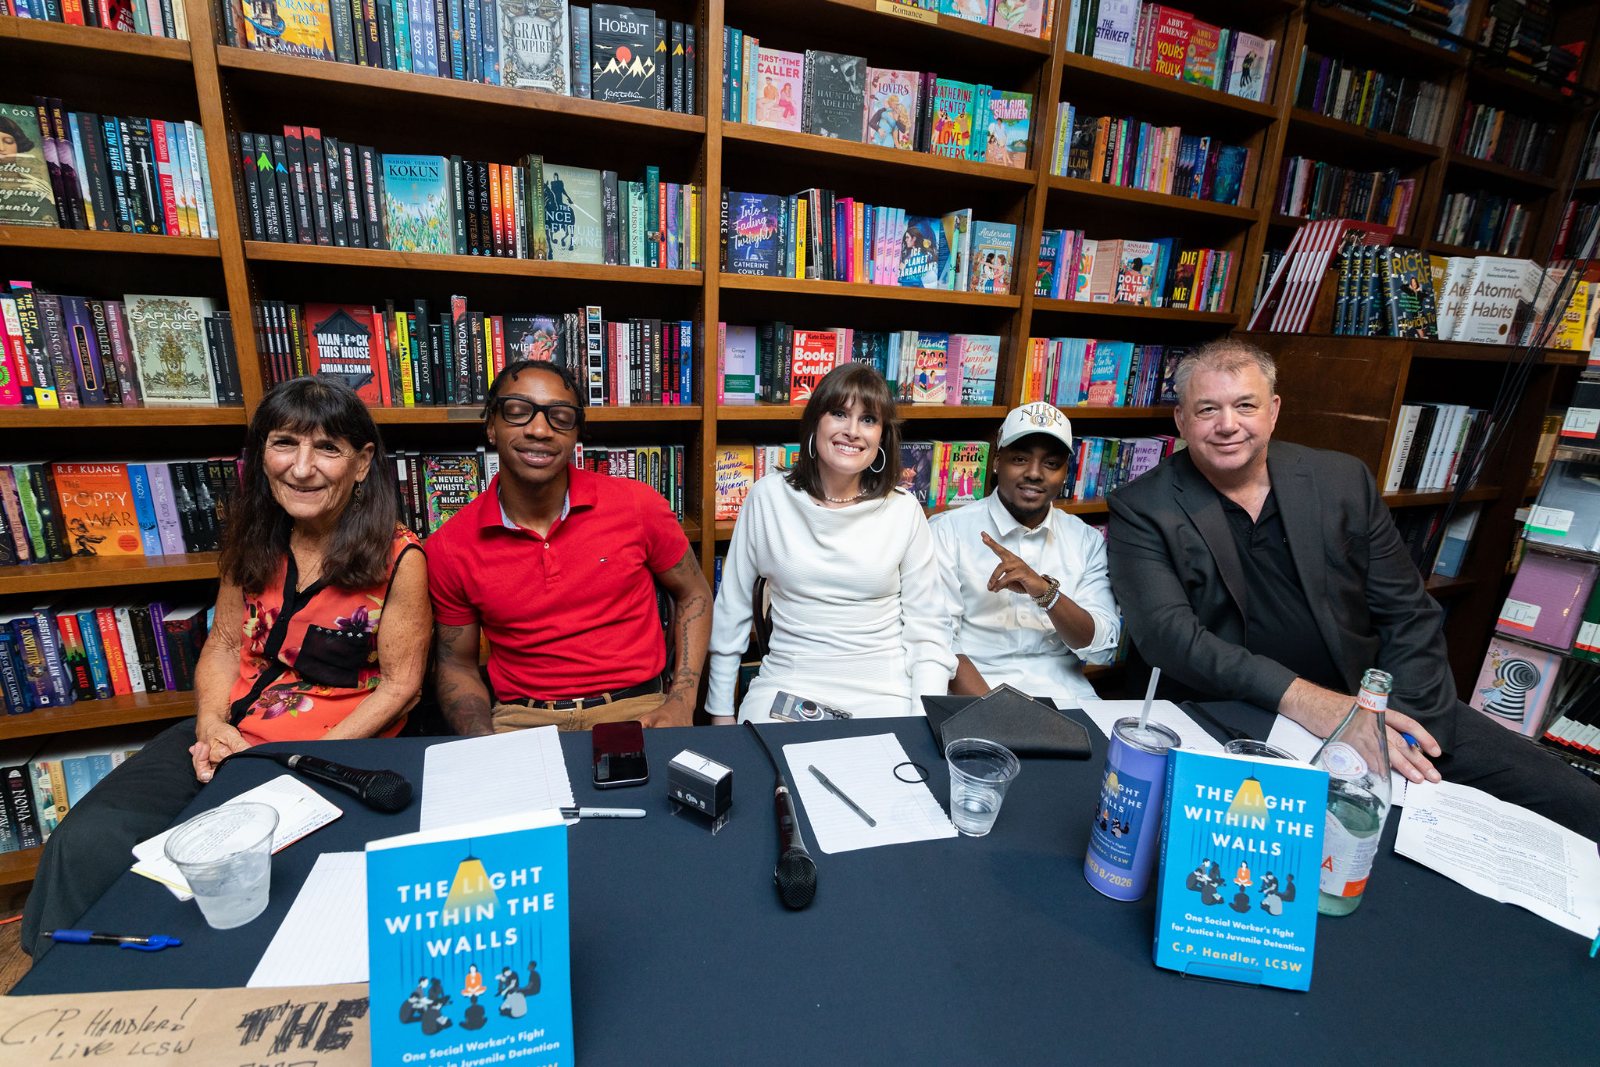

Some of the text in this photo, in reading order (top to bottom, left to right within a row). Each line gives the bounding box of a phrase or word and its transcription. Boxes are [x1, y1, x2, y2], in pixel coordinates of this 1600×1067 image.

[396, 2, 404, 24] HEELS
[891, 4, 924, 19] Romance
[292, 14, 320, 26] TREE
[598, 18, 649, 36] HOBBIT
[1101, 19, 1114, 29] THE
[1166, 17, 1185, 29] ABBY
[370, 22, 378, 42] FIELD
[513, 21, 552, 40] GRAVE
[1095, 27, 1130, 44] STRIKER
[1158, 24, 1189, 40] JIMENEZ
[1196, 28, 1213, 40] ABBY
[270, 40, 325, 57] SAMANTHA
[514, 38, 552, 54] EMPIRE
[1157, 40, 1185, 60] YOURS
[1190, 36, 1217, 50] JIMENEZ
[758, 54, 800, 67] FIRST-TIME
[1155, 60, 1181, 76] TRULY
[757, 62, 800, 79] CALLER
[818, 90, 862, 102] HAUNTING
[878, 82, 910, 96] LOVERS
[935, 86, 972, 101] KATHERINE
[822, 100, 856, 110] ADELINE
[940, 100, 967, 116] CENTER
[989, 98, 1026, 110] RICH GIRL
[993, 108, 1028, 120] SUMMER
[938, 130, 961, 144] LOVE
[930, 146, 966, 158] HATERS
[104, 122, 129, 221] SLOW RIVER NICOLA GRIFFITH
[389, 166, 438, 178] KOKUN
[466, 164, 474, 188] ANDY
[470, 212, 478, 246] ARTEMIS
[739, 204, 760, 218] Into
[282, 196, 294, 238] SILMARILLION
[546, 212, 572, 222] NCE
[734, 215, 768, 231] Fading
[482, 214, 490, 248] ARTEMIS
[730, 226, 771, 249] Twilight
[978, 228, 1011, 239] Anderson
[910, 246, 921, 256] ICE
[991, 239, 1012, 248] Bloom
[1126, 242, 1150, 250] ANNABEL
[734, 261, 768, 270] CATHERINE
[904, 255, 928, 268] PLANET
[1180, 251, 1197, 266] DIE
[1392, 255, 1424, 274] RICH
[738, 268, 764, 276] COWLES
[1118, 274, 1148, 285] DOLLY
[1418, 268, 1430, 284] AF
[1132, 284, 1147, 292] THE
[1172, 286, 1187, 300] ME
[1474, 281, 1522, 299] Atomic
[1119, 292, 1142, 302] TIME
[16, 298, 26, 312] WE
[24, 294, 38, 330] THE CITY
[1471, 302, 1514, 319] Habits
[131, 308, 198, 322] SAPLING
[20, 314, 34, 344] BECAME
[92, 304, 109, 356] GODKILLER
[148, 321, 192, 330] CAGE
[45, 309, 64, 364] OBELISK GATE
[458, 322, 468, 356] WORLD
[795, 332, 806, 347] If
[820, 334, 835, 342] Eberle
[318, 346, 370, 359] THIS HOUSE
[794, 348, 834, 362] Books
[321, 363, 372, 374] BRIAN ASMAN
[419, 341, 430, 384] SLEWFOOT
[460, 356, 468, 376] WAR
[794, 360, 832, 374] Could
[916, 354, 940, 368] Clue
[968, 364, 990, 377] After
[793, 376, 815, 388] Kill
[1020, 404, 1064, 427] NIKE
[724, 452, 740, 461] This
[952, 452, 984, 463] Bride
[970, 446, 980, 454] the
[1397, 429, 1414, 473] Capitalism
[57, 464, 120, 474] R.F. KUANG
[716, 461, 746, 472] Summer
[1132, 464, 1149, 472] LEFT
[718, 470, 742, 482] Will Be
[135, 474, 144, 499] DRAGON
[714, 480, 748, 496] Different
[62, 492, 128, 508] POPPY
[441, 496, 465, 504] NIGHT
[85, 512, 134, 527] WAR
[37, 615, 60, 677] ASSISTANT VILLAIN
[76, 666, 88, 688] WICKED
[12, 788, 31, 822] NONA
[1122, 796, 1142, 809] THE
[1195, 784, 1307, 814] THE LIGHT
[1184, 804, 1314, 838] WITHIN THE
[1212, 832, 1282, 856] WALLS
[397, 866, 543, 904] THE LIGHT
[1099, 869, 1132, 888] 8/2026
[384, 892, 555, 936] WITHIN THE
[1184, 913, 1295, 938] One Social Worker's Fight
[426, 928, 518, 958] WALLS
[1172, 922, 1306, 952] for Justice in Juvenile Detention
[1172, 942, 1302, 973] C.P. Handler, LCSW
[236, 996, 368, 1056] THE
[402, 1028, 545, 1064] One Social Worker's Fight
